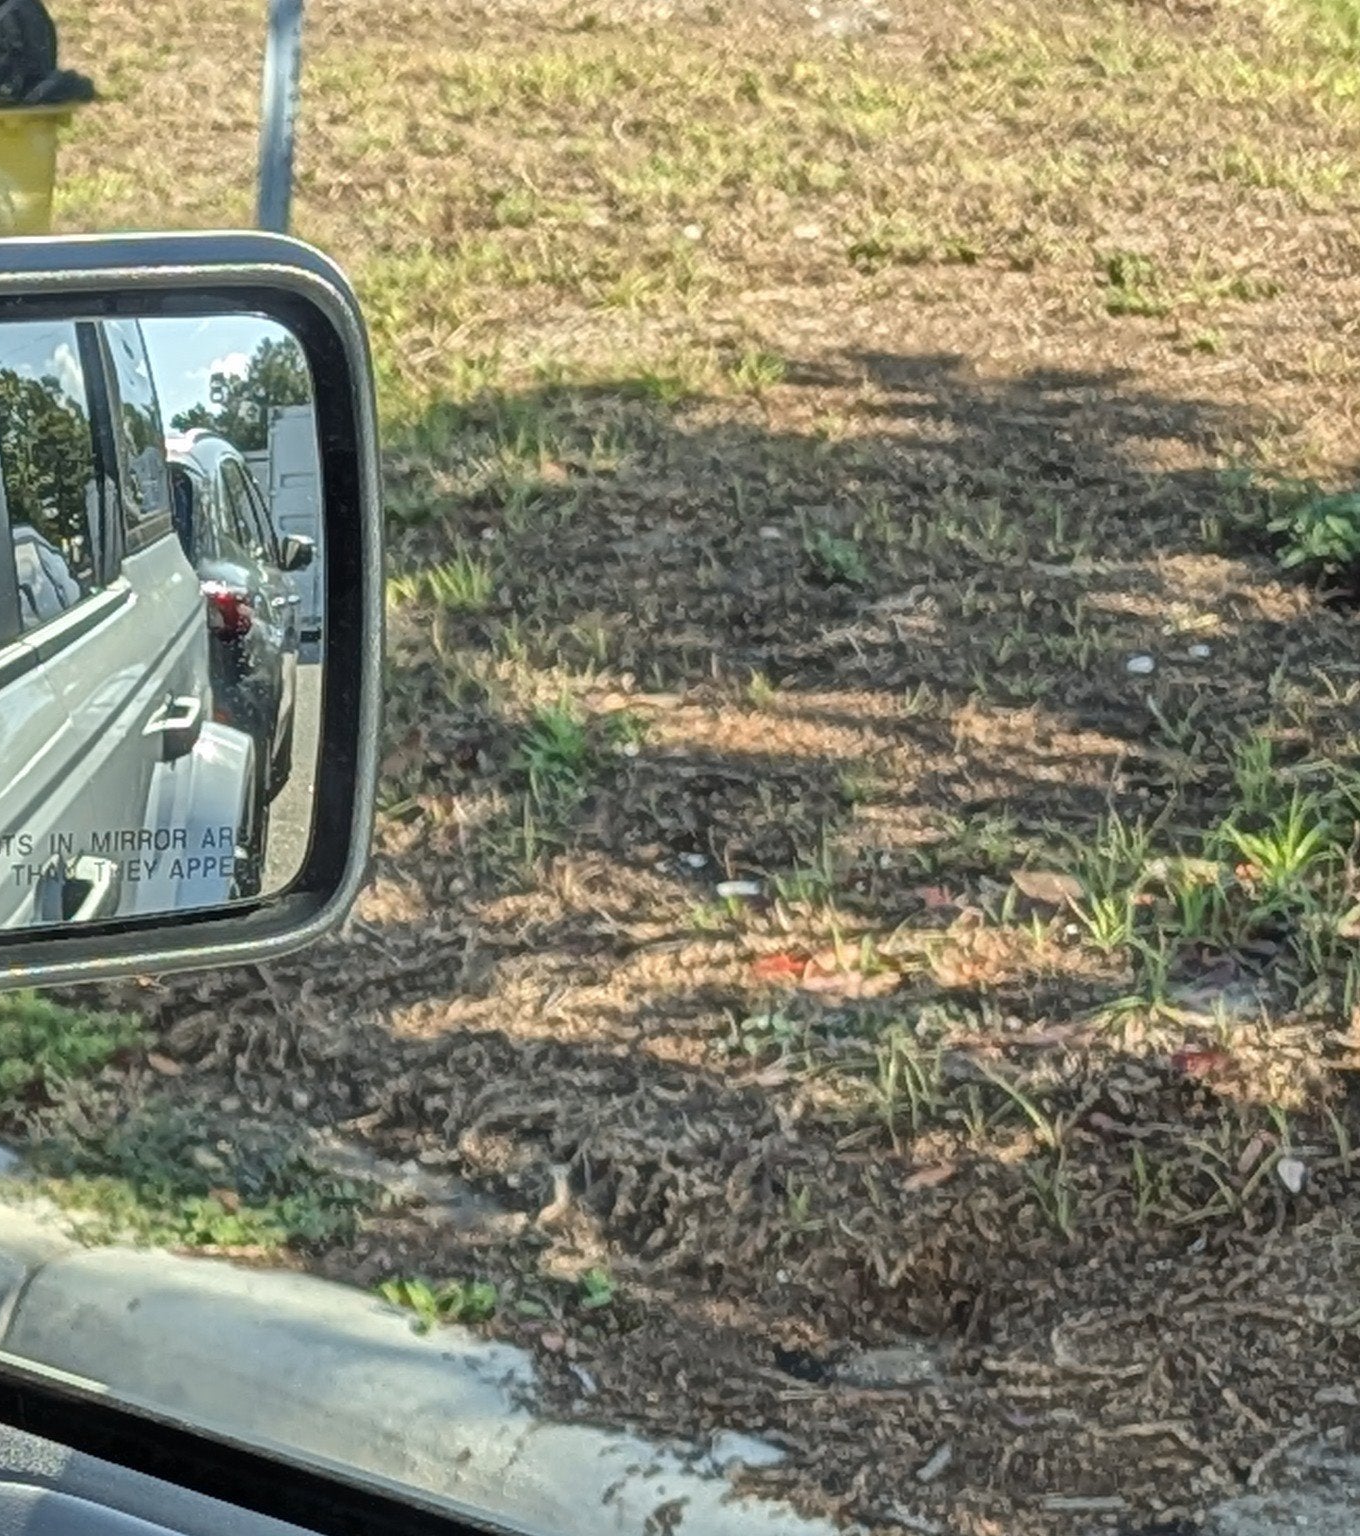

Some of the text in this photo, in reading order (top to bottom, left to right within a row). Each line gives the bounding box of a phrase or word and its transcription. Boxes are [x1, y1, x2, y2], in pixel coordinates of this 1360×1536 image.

[49, 832, 75, 855] IN
[90, 828, 187, 853] MIRROR
[200, 826, 244, 849] AR
[169, 855, 240, 879] APPE
